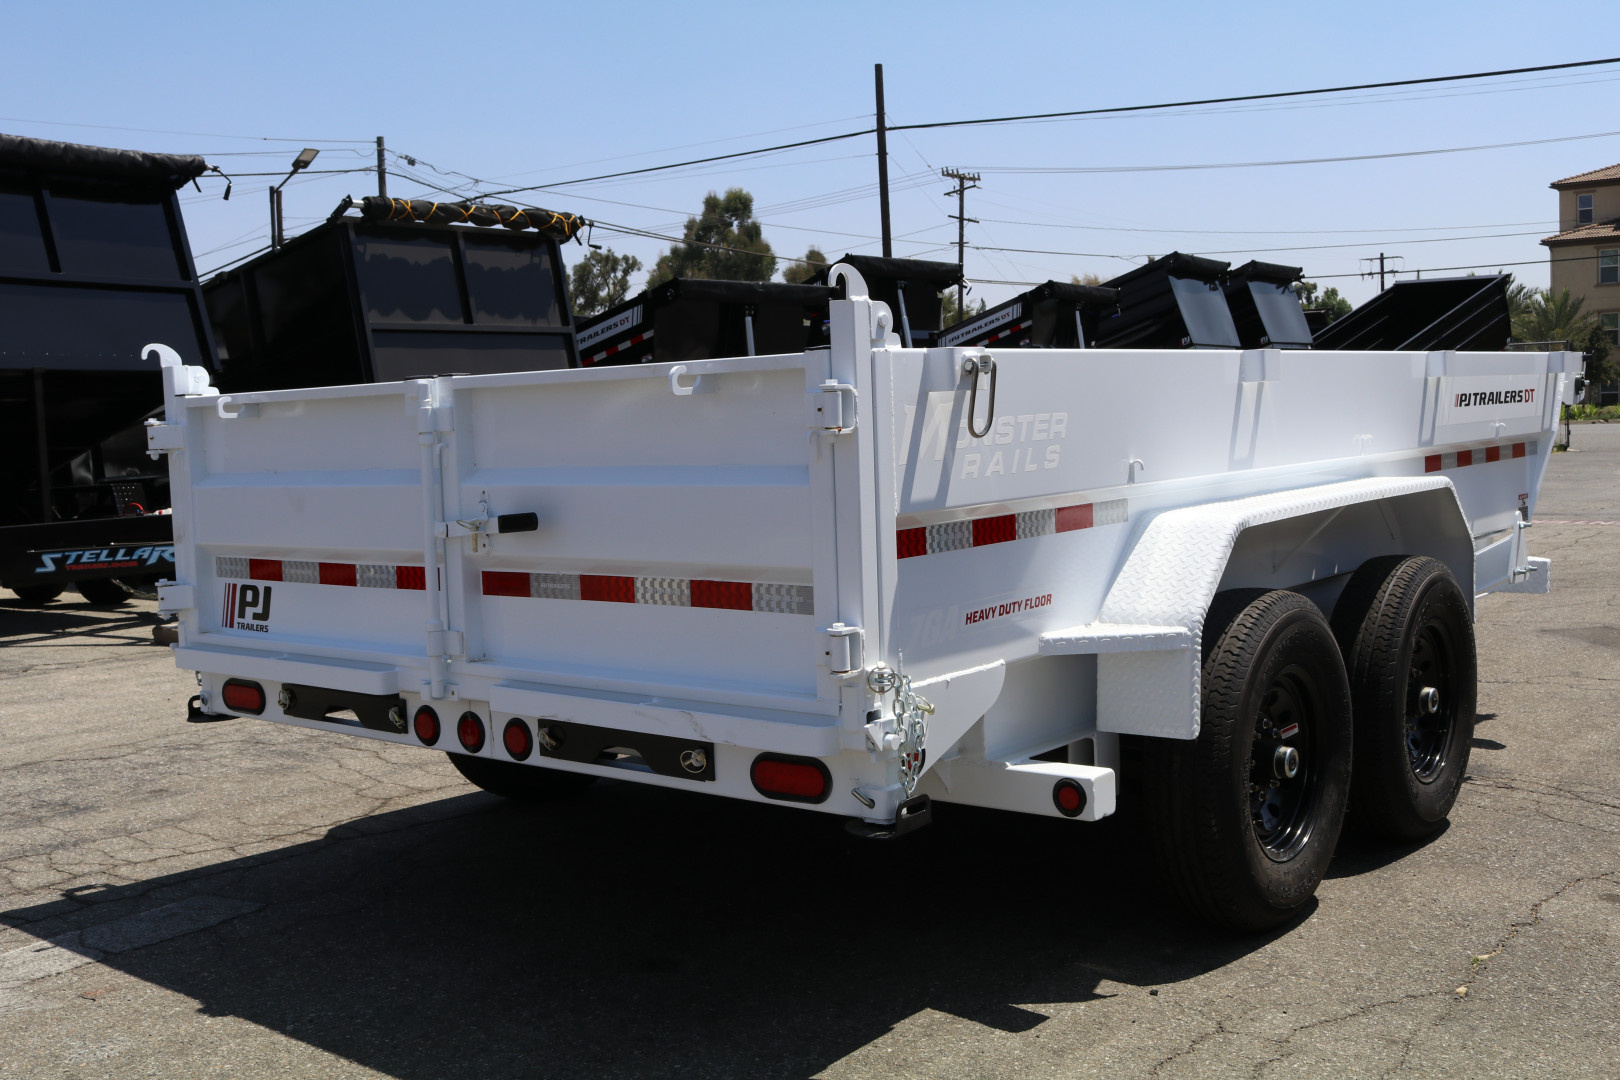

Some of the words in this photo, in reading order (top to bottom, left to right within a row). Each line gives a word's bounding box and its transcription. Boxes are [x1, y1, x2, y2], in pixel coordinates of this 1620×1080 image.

[619, 315, 630, 326] DT
[960, 316, 1001, 338] TRAILERS
[1001, 311, 1011, 320] DT
[1472, 389, 1524, 407] TRAILERS
[1524, 388, 1536, 403] DT
[960, 444, 1061, 480] RAILS
[237, 584, 272, 621] PJ
[965, 606, 998, 625] HEAVY
[999, 599, 1023, 617] DUTY
[1024, 593, 1053, 611] FLOOR
[237, 621, 269, 632] TRAILERS
